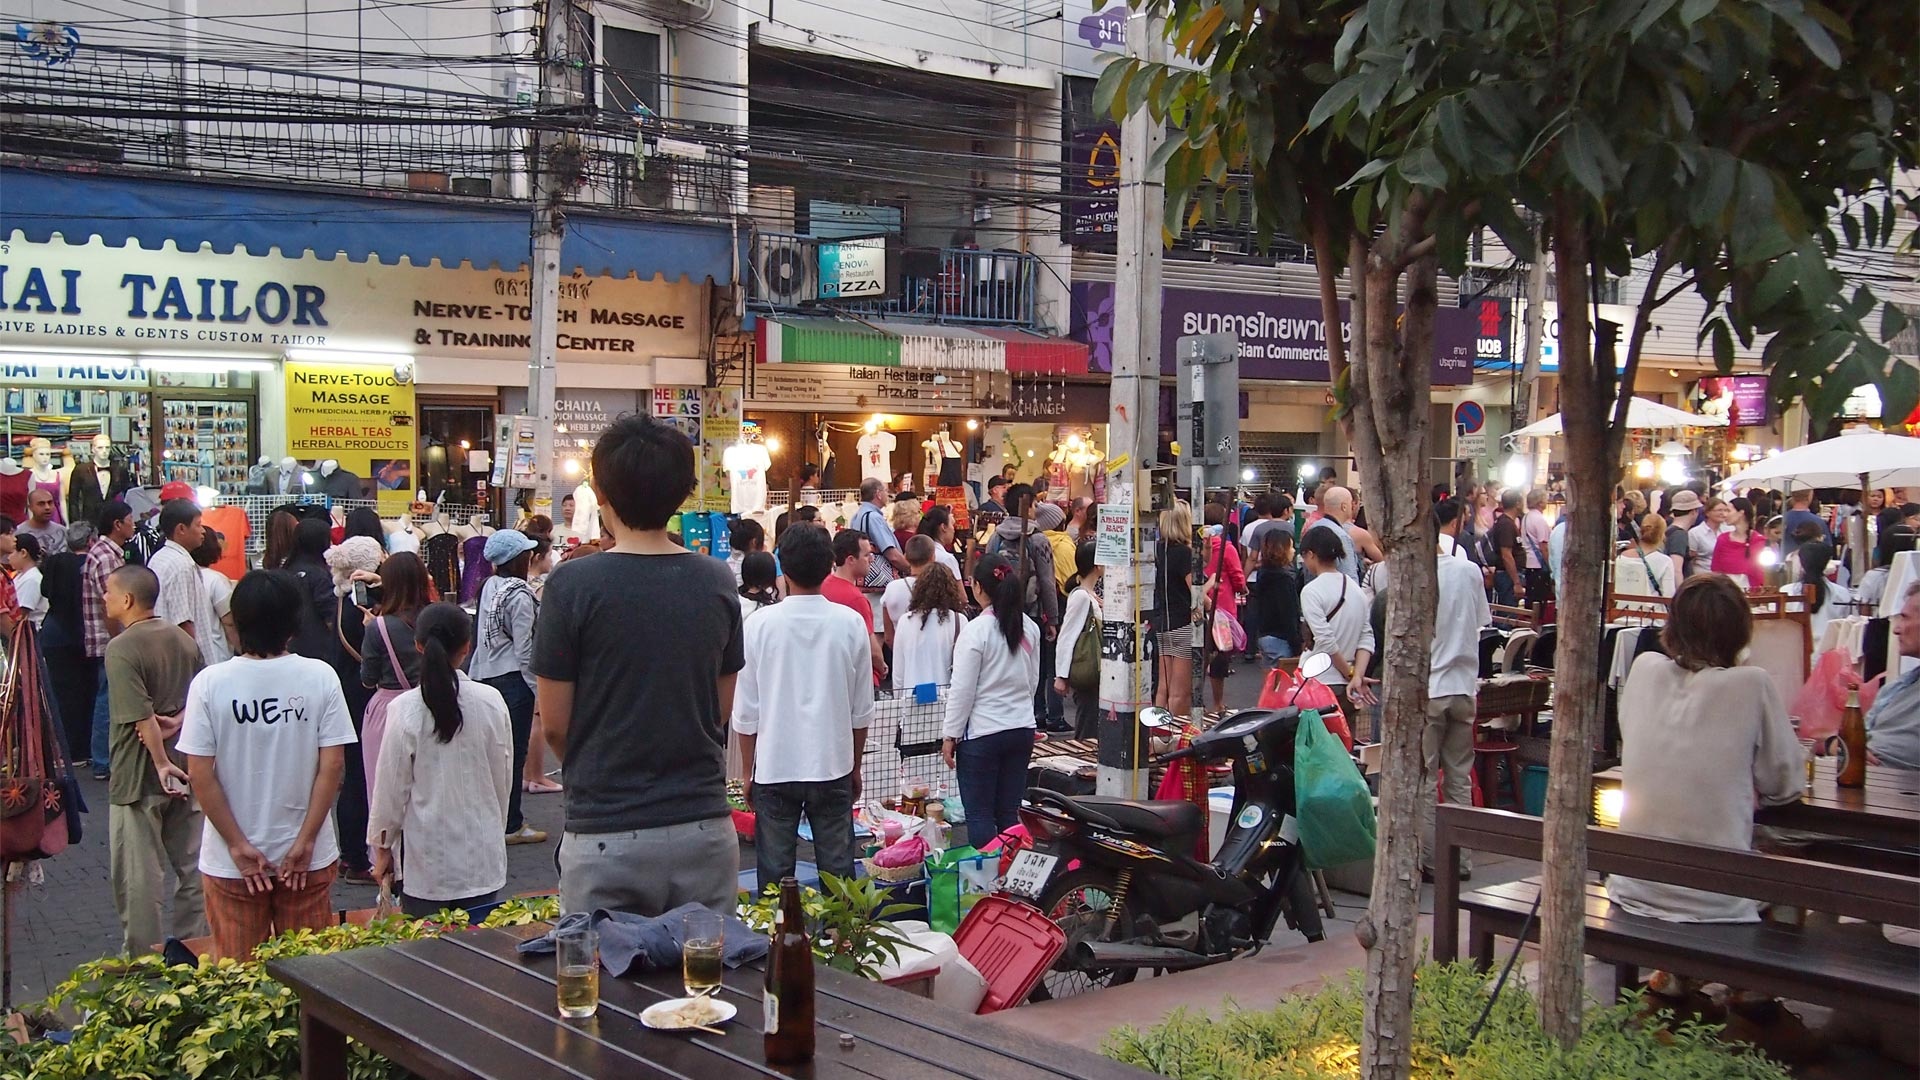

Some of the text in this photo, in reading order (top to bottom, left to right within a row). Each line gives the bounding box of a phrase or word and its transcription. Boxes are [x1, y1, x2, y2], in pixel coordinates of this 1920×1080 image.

[823, 280, 881, 294] PIZZA
[0, 264, 328, 326] AI TAILOR
[591, 308, 685, 329] MASSAGE
[44, 323, 107, 336] LADIES
[115, 327, 126, 337] &
[135, 327, 189, 340] GENTS
[197, 330, 263, 344] CUSTOM
[271, 334, 326, 346] TAILOR
[415, 327, 431, 345] &
[556, 333, 635, 352] CENTER
[1267, 344, 1330, 362] Commercia
[1476, 338, 1503, 354] UOB
[294, 371, 406, 387] NERVE-TOUC
[849, 366, 880, 380] Italian
[312, 391, 390, 405] MASSAGE
[654, 388, 700, 401] HERBAL
[554, 399, 602, 412] CHAIYA
[654, 402, 700, 415] TEAS
[575, 413, 607, 421] MASSAGE
[310, 426, 392, 437] HERBAL TEAS
[292, 440, 409, 449] HERBAL PRODUCTS
